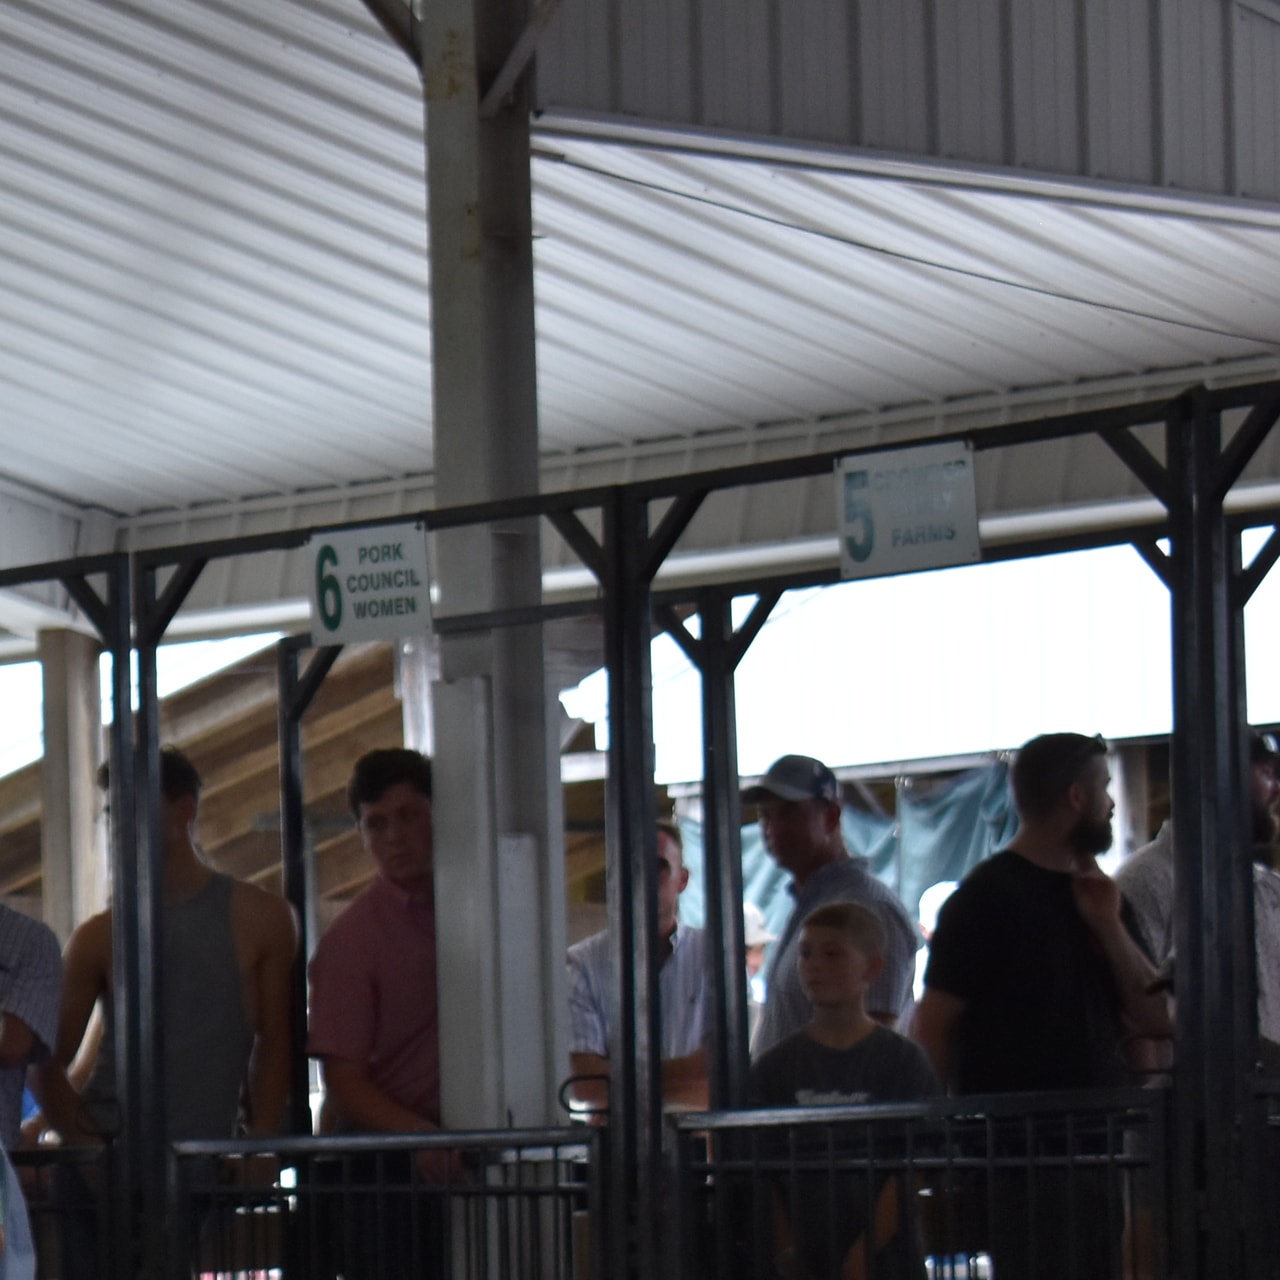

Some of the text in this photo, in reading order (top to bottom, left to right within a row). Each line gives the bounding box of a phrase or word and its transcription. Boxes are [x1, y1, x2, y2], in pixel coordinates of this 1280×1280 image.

[844, 470, 874, 563] 5
[892, 523, 956, 547] FARMS
[358, 543, 403, 565] PORK
[315, 544, 343, 632] 6
[346, 568, 420, 593] COUNCIL
[353, 596, 417, 619] WOMEN
